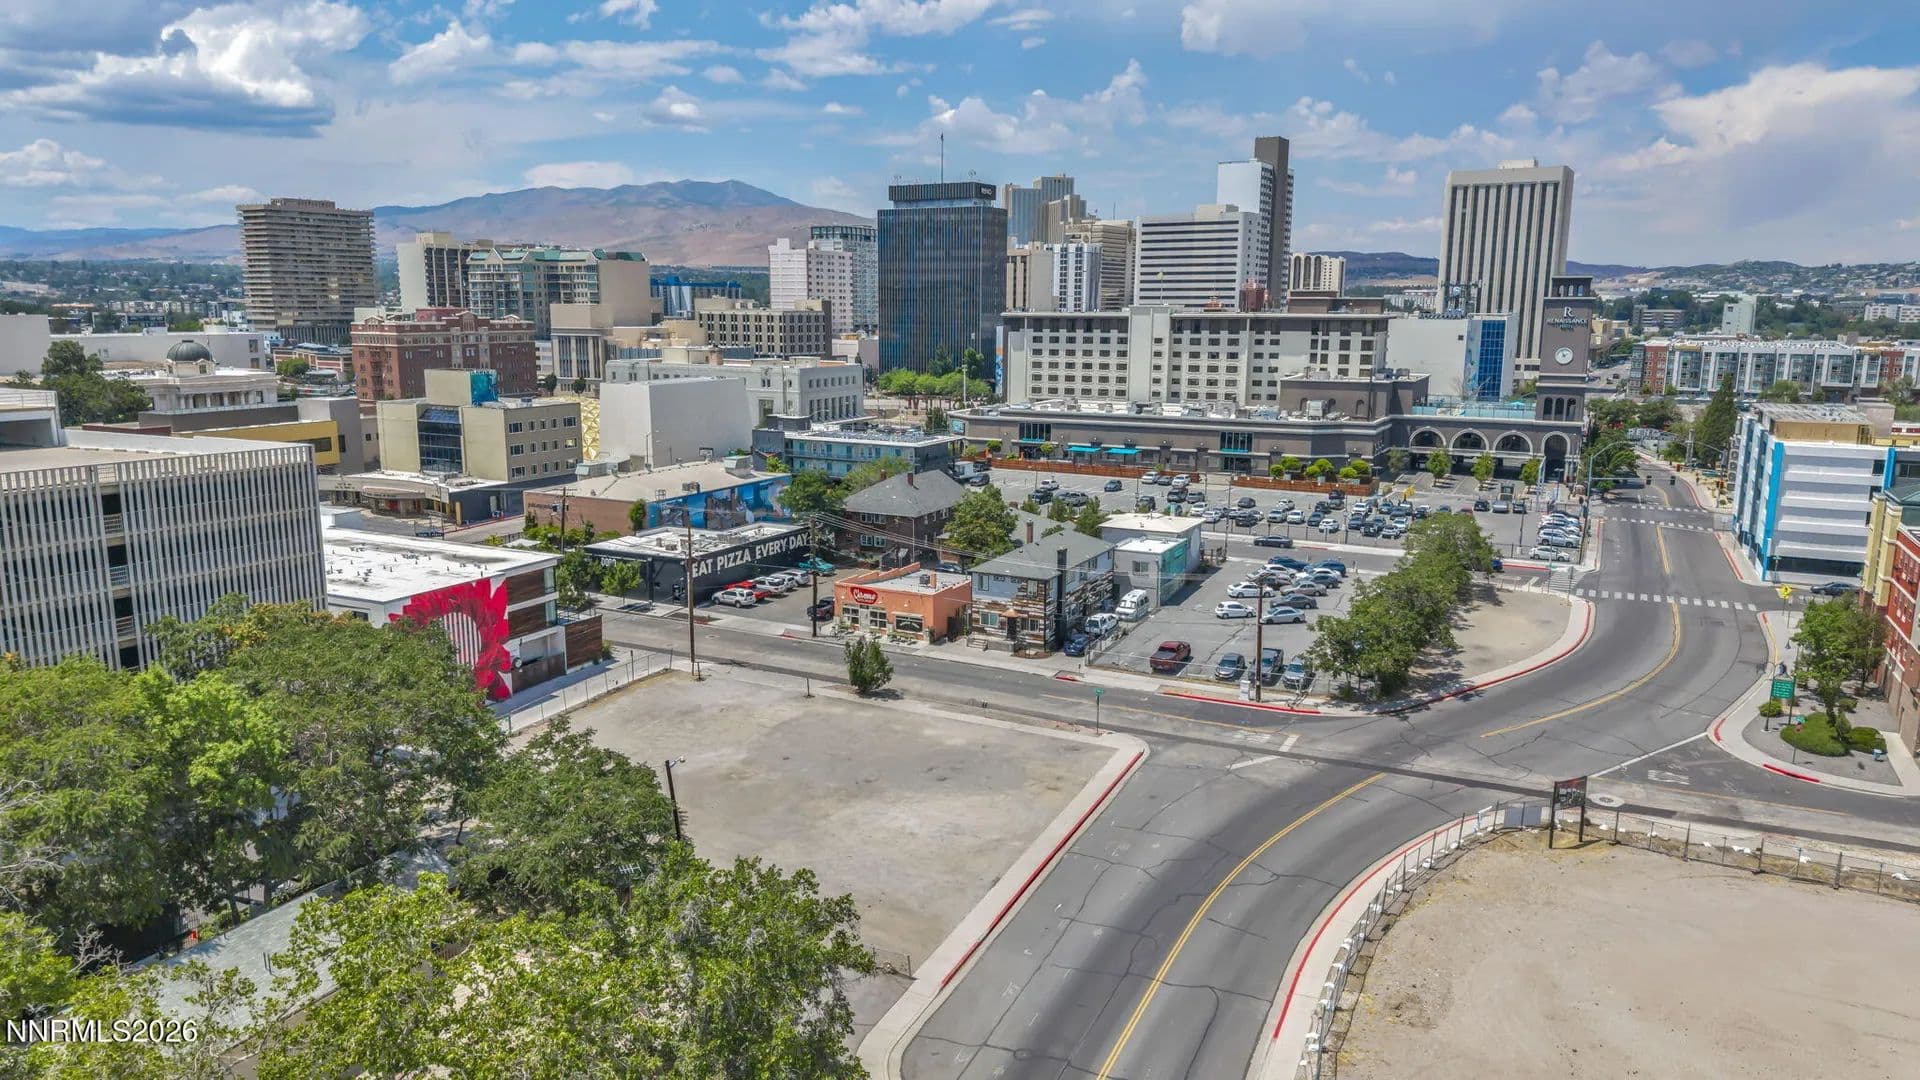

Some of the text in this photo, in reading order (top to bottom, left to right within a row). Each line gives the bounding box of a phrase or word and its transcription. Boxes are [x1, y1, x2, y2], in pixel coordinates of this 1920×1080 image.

[692, 559, 713, 578] EAT
[717, 548, 751, 570] PIZZA
[755, 538, 789, 559] EVERY
[789, 532, 809, 550] DAY
